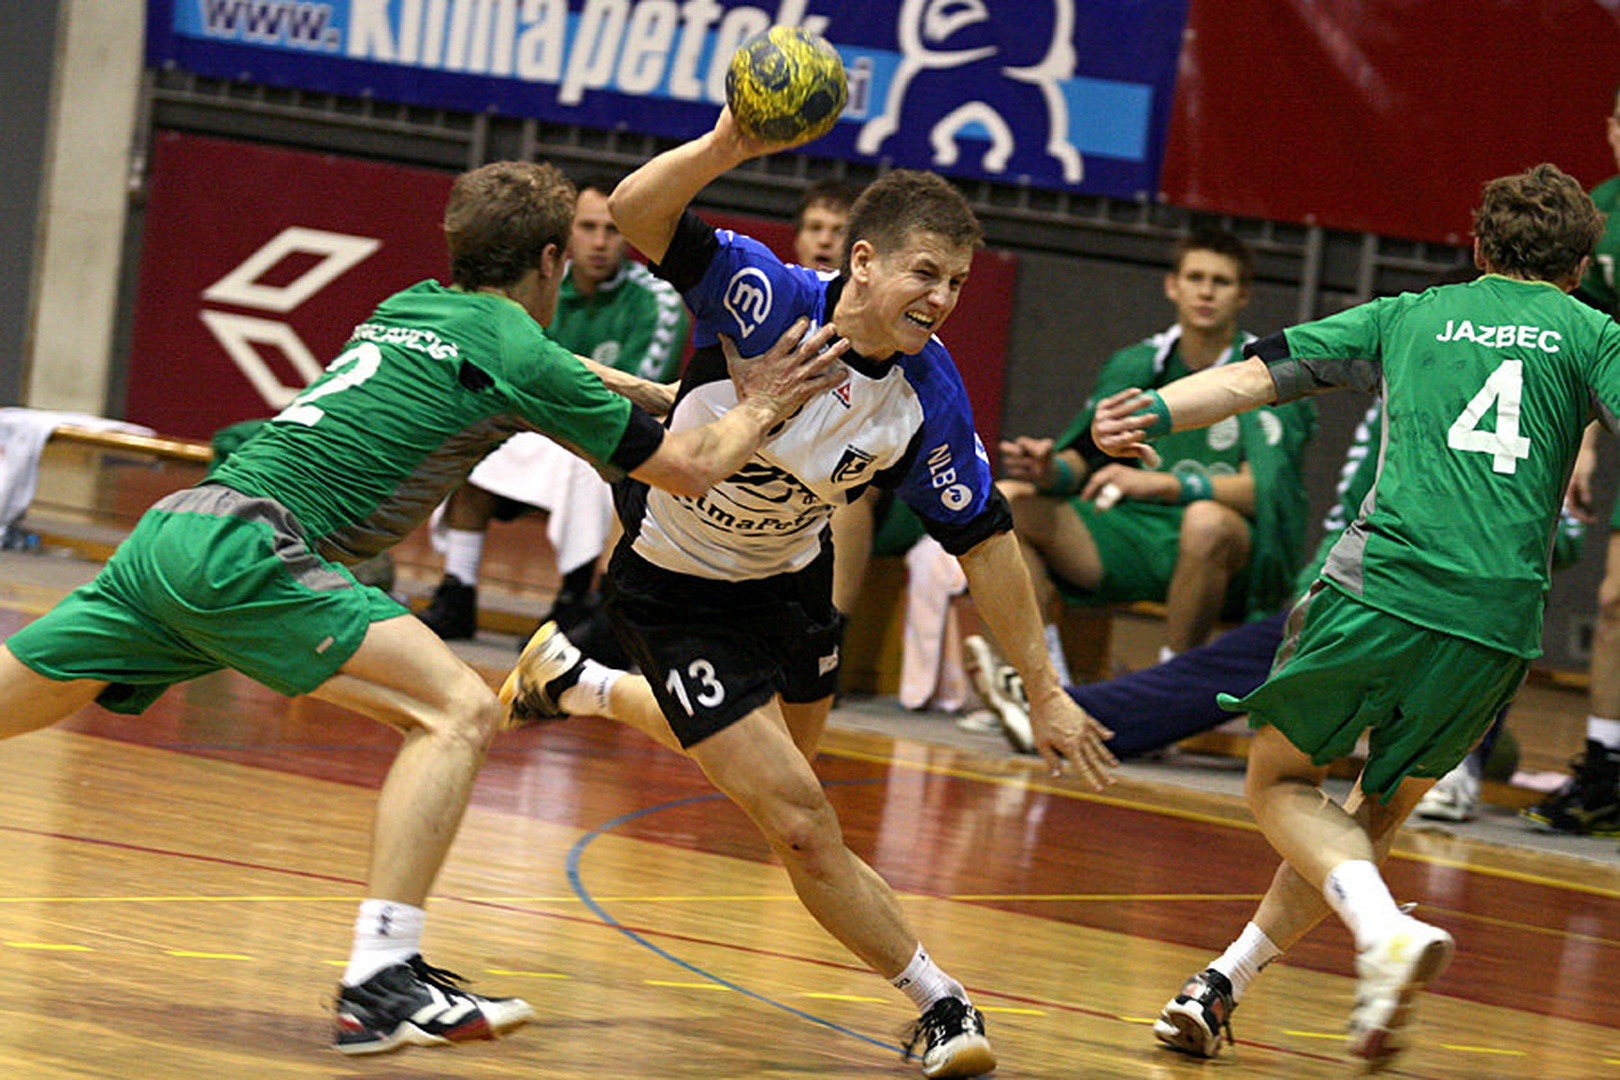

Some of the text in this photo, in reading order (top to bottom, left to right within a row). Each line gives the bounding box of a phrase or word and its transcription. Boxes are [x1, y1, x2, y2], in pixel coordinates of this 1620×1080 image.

[1435, 320, 1562, 353] JAZBEC
[272, 342, 382, 427] 2
[1448, 359, 1531, 474] 4
[928, 443, 957, 489] NLB
[665, 658, 726, 717] 13
